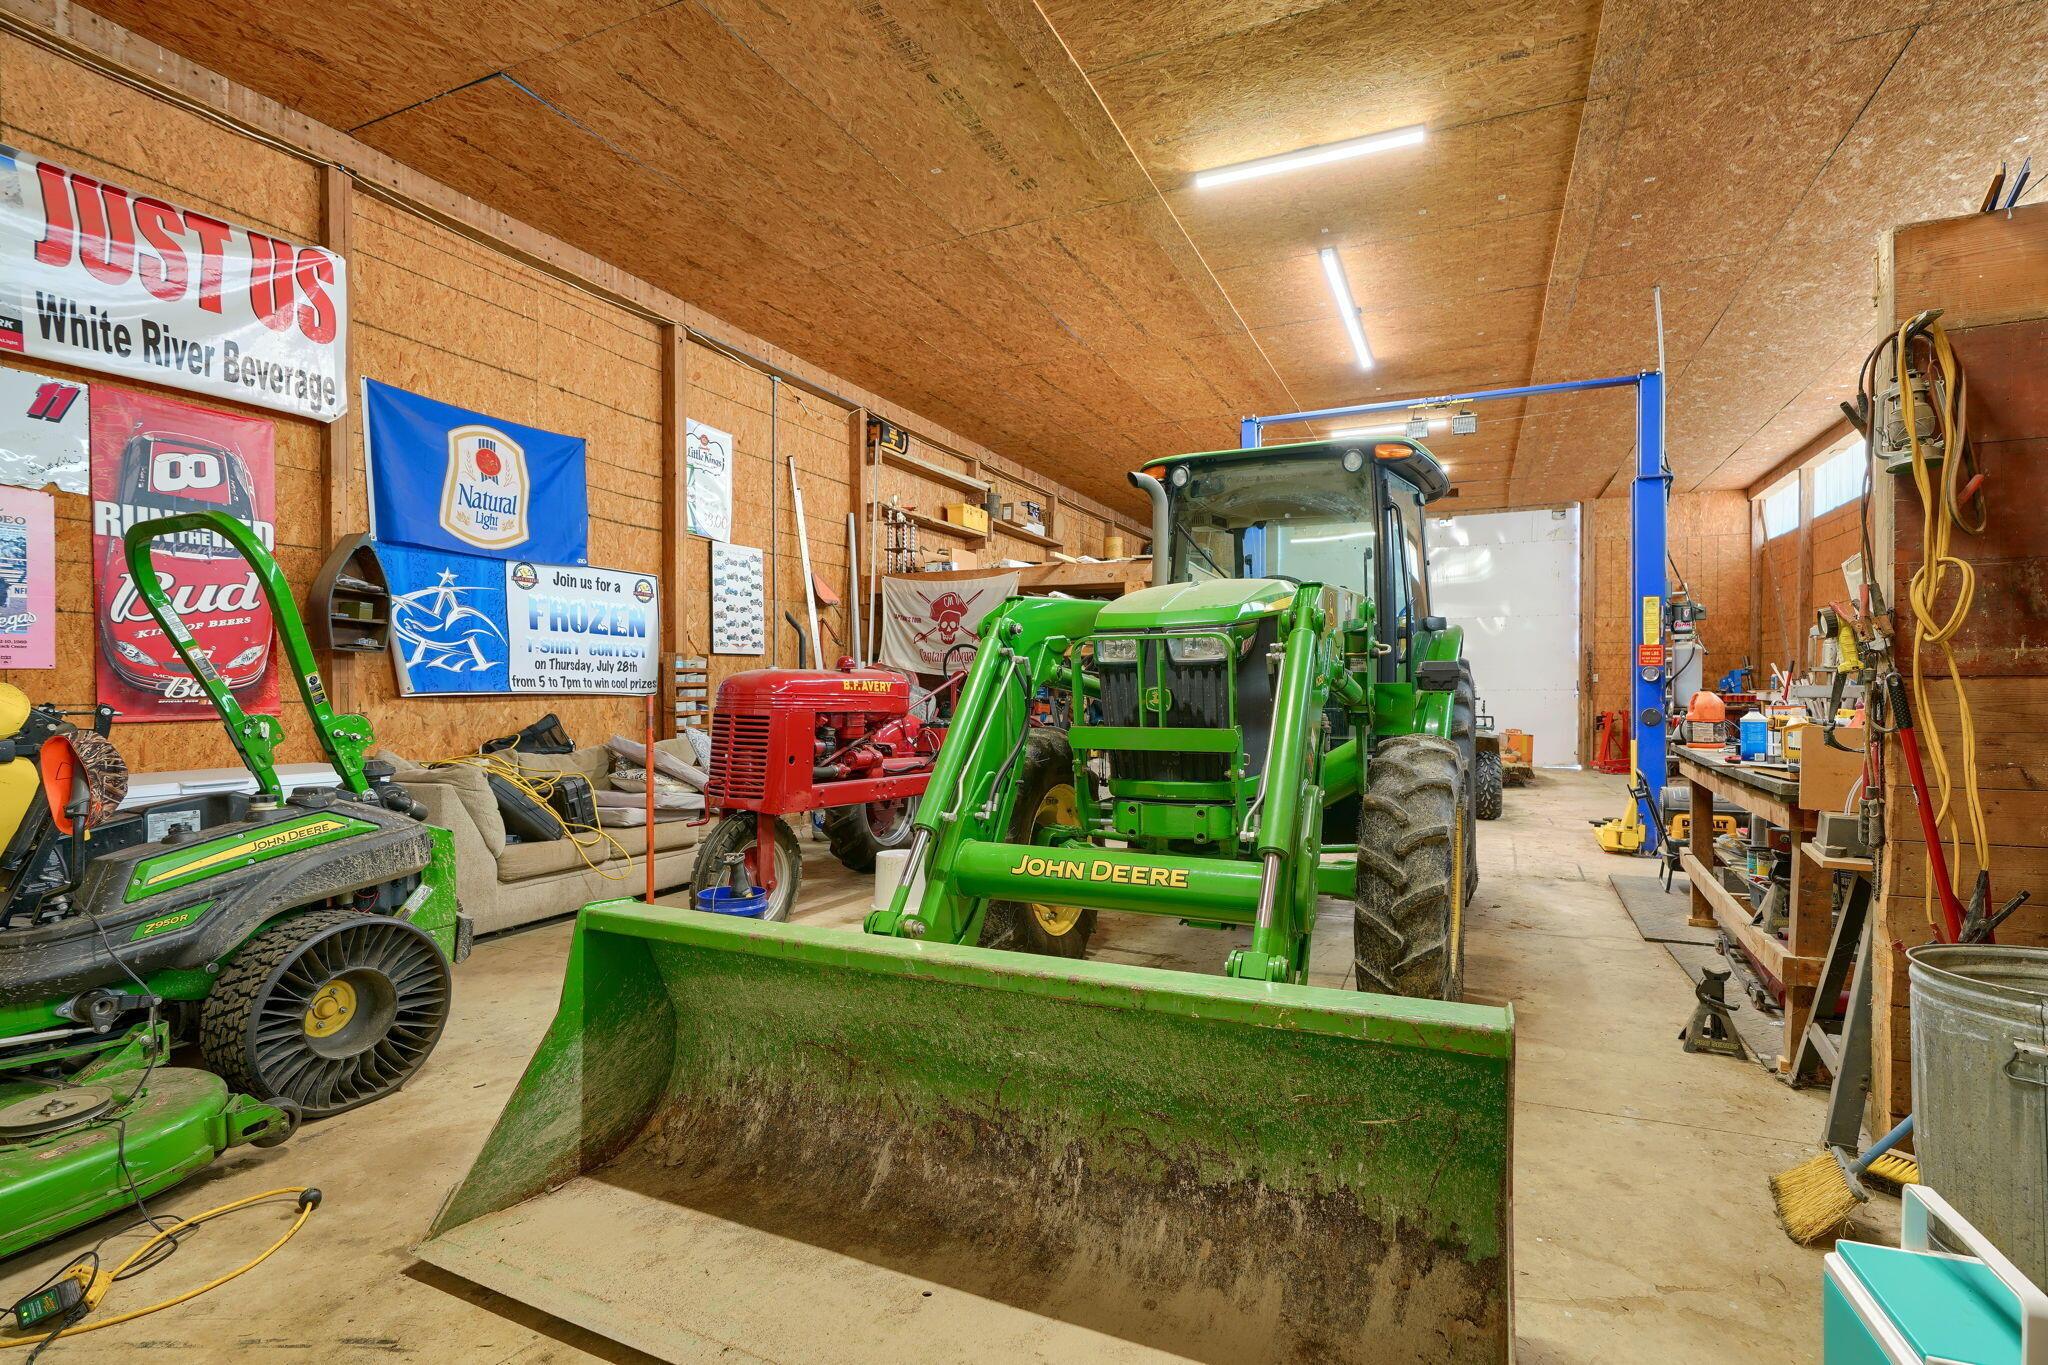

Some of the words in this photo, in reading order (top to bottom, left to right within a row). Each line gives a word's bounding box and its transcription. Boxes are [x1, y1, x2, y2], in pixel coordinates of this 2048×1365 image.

[34, 162, 232, 315] JUST
[247, 231, 336, 345] US
[36, 291, 132, 359] White
[141, 318, 215, 378] River
[223, 340, 336, 413] Beverage
[27, 383, 81, 423] 11
[687, 446, 704, 462] Little
[704, 451, 722, 468] Kings
[153, 452, 221, 492] 8
[458, 483, 517, 515] Natural
[475, 511, 498, 530] Light
[179, 530, 210, 546] THE
[553, 571, 577, 588] Join
[580, 579, 592, 590] us
[596, 577, 611, 592] for
[614, 582, 621, 593] a
[111, 571, 262, 623] Bud
[136, 628, 166, 639] KIN
[187, 621, 204, 631] OF
[208, 616, 252, 628] BEERS
[528, 594, 646, 638] FROZEN
[526, 637, 579, 655] T-SHIRT
[589, 641, 647, 658] CONTEST
[919, 649, 947, 665] Captain
[534, 660, 546, 670] on
[549, 658, 594, 673] Thursday,
[596, 661, 614, 672] July
[617, 661, 637, 672] 28th
[511, 675, 536, 688] from
[538, 676, 545, 687] 5
[549, 677, 558, 688] to
[560, 676, 581, 690] 7pm
[583, 678, 592, 688] to
[594, 678, 609, 688] win
[611, 678, 627, 689] cool
[629, 678, 657, 691] prizes
[251, 835, 286, 851] JOHN
[288, 823, 330, 840] DEERE
[1011, 855, 1086, 880] JOHN
[1090, 859, 1190, 888] DEERE
[143, 913, 189, 935] Z950R
